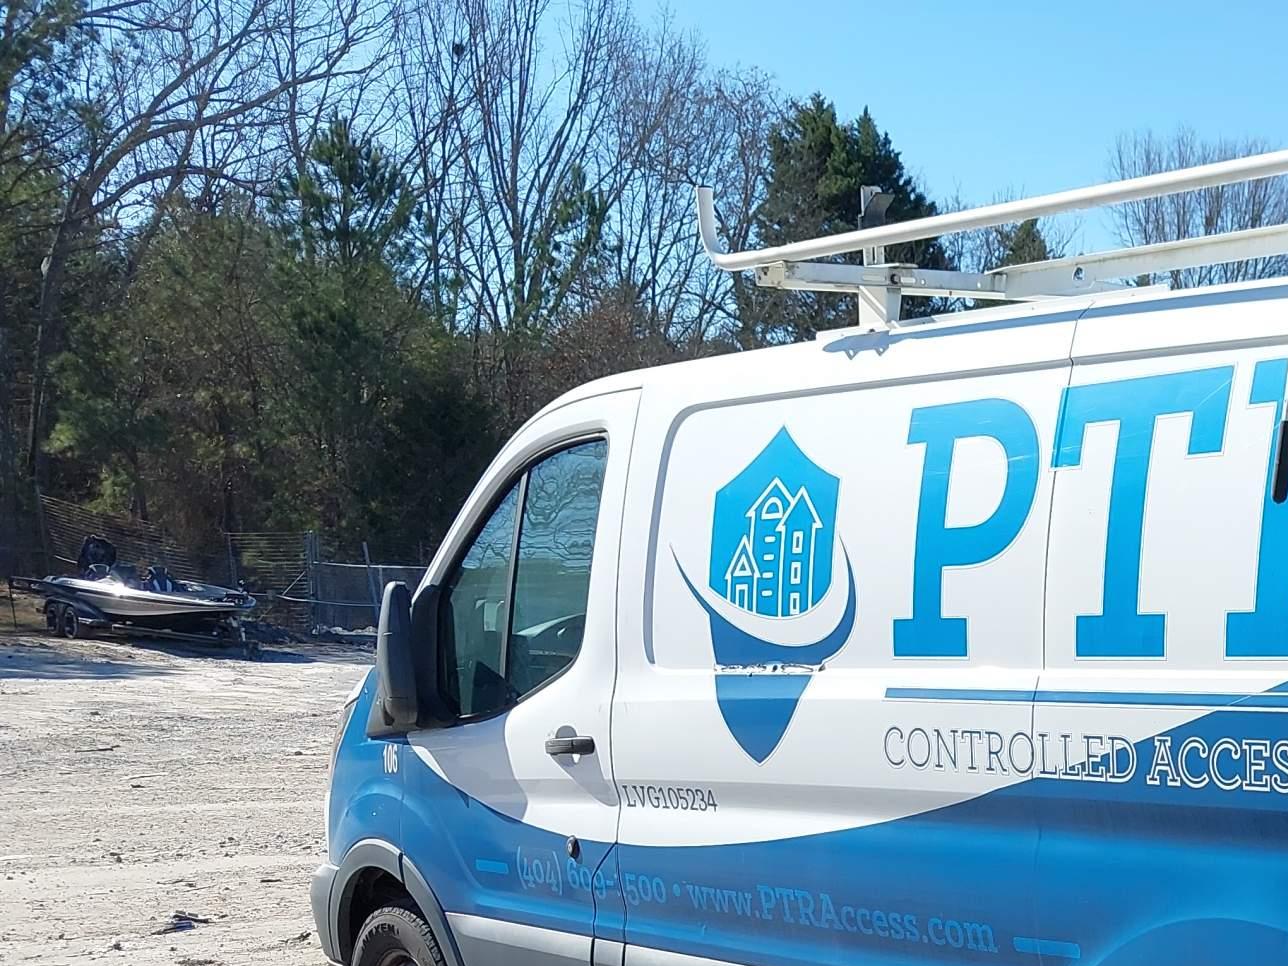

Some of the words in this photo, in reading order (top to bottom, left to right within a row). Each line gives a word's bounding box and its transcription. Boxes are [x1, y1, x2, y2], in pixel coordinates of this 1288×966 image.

[383, 743, 398, 774] 106
[884, 726, 1137, 785] CONTROLLED
[622, 785, 718, 812] LVG105234
[517, 846, 563, 896] (404)
[686, 880, 998, 952] www.PTRAccess.com
